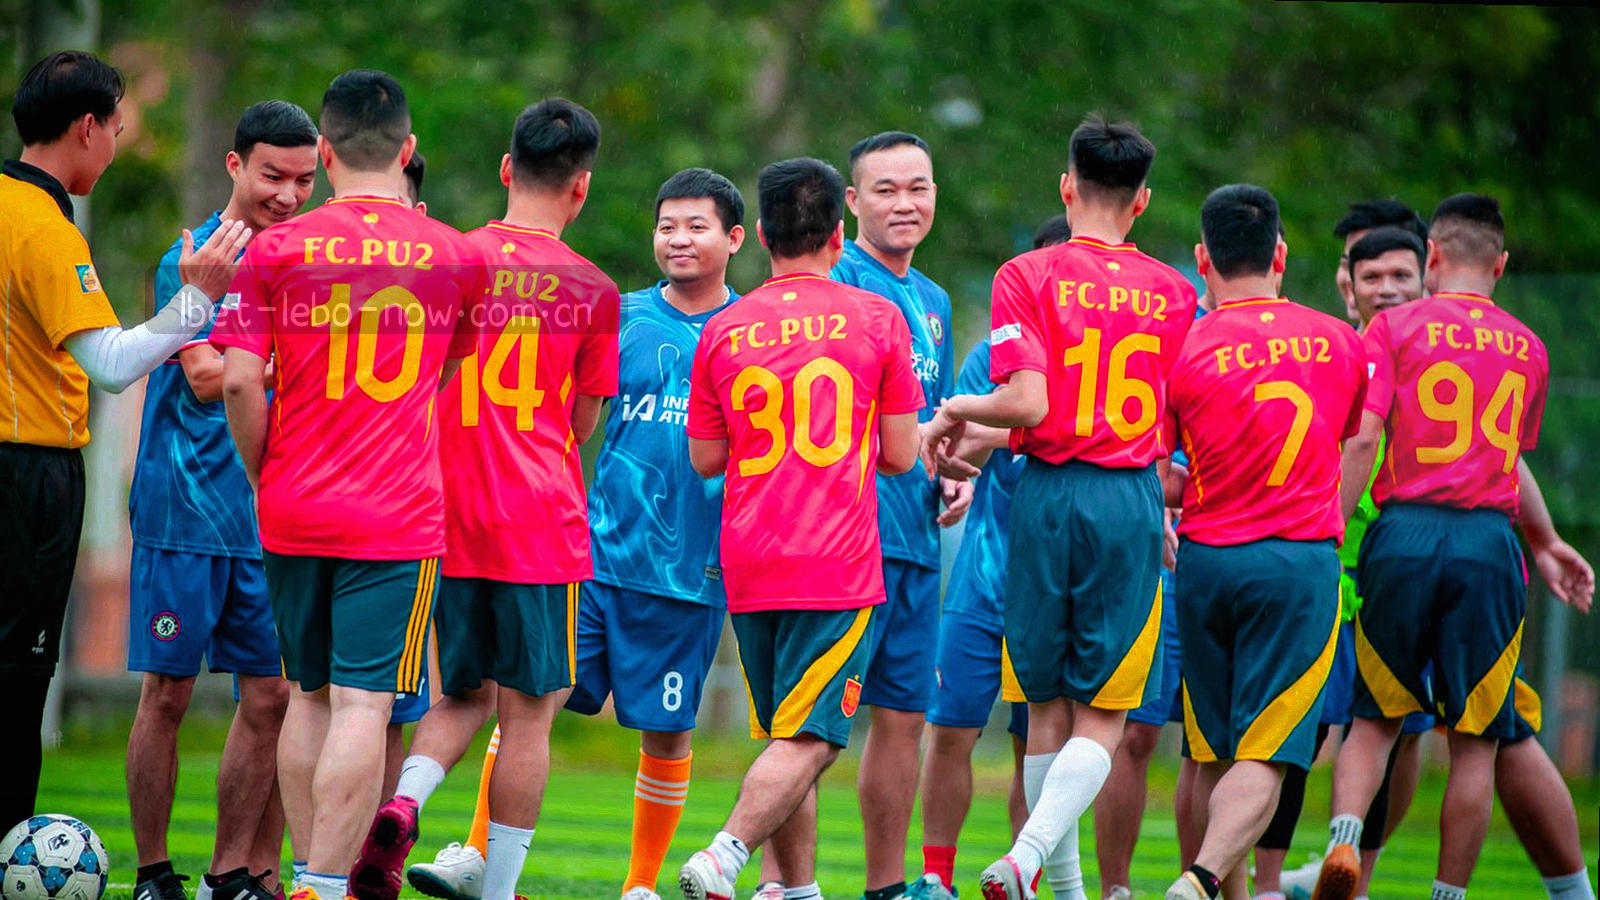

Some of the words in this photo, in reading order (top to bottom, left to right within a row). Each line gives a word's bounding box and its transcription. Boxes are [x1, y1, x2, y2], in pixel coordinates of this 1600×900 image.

[304, 236, 434, 270] FC.PU2
[729, 314, 848, 354] FC.PU2
[1059, 280, 1167, 321] FC.PU2
[310, 284, 426, 402] 10
[461, 315, 545, 431] 14
[1215, 337, 1332, 374] FC.PU2
[1427, 322, 1529, 362] FC.PU2
[731, 356, 853, 477] 30
[1064, 327, 1161, 442] 16
[1416, 360, 1527, 474] 94
[1254, 381, 1313, 487] 7
[662, 671, 683, 712] 8
